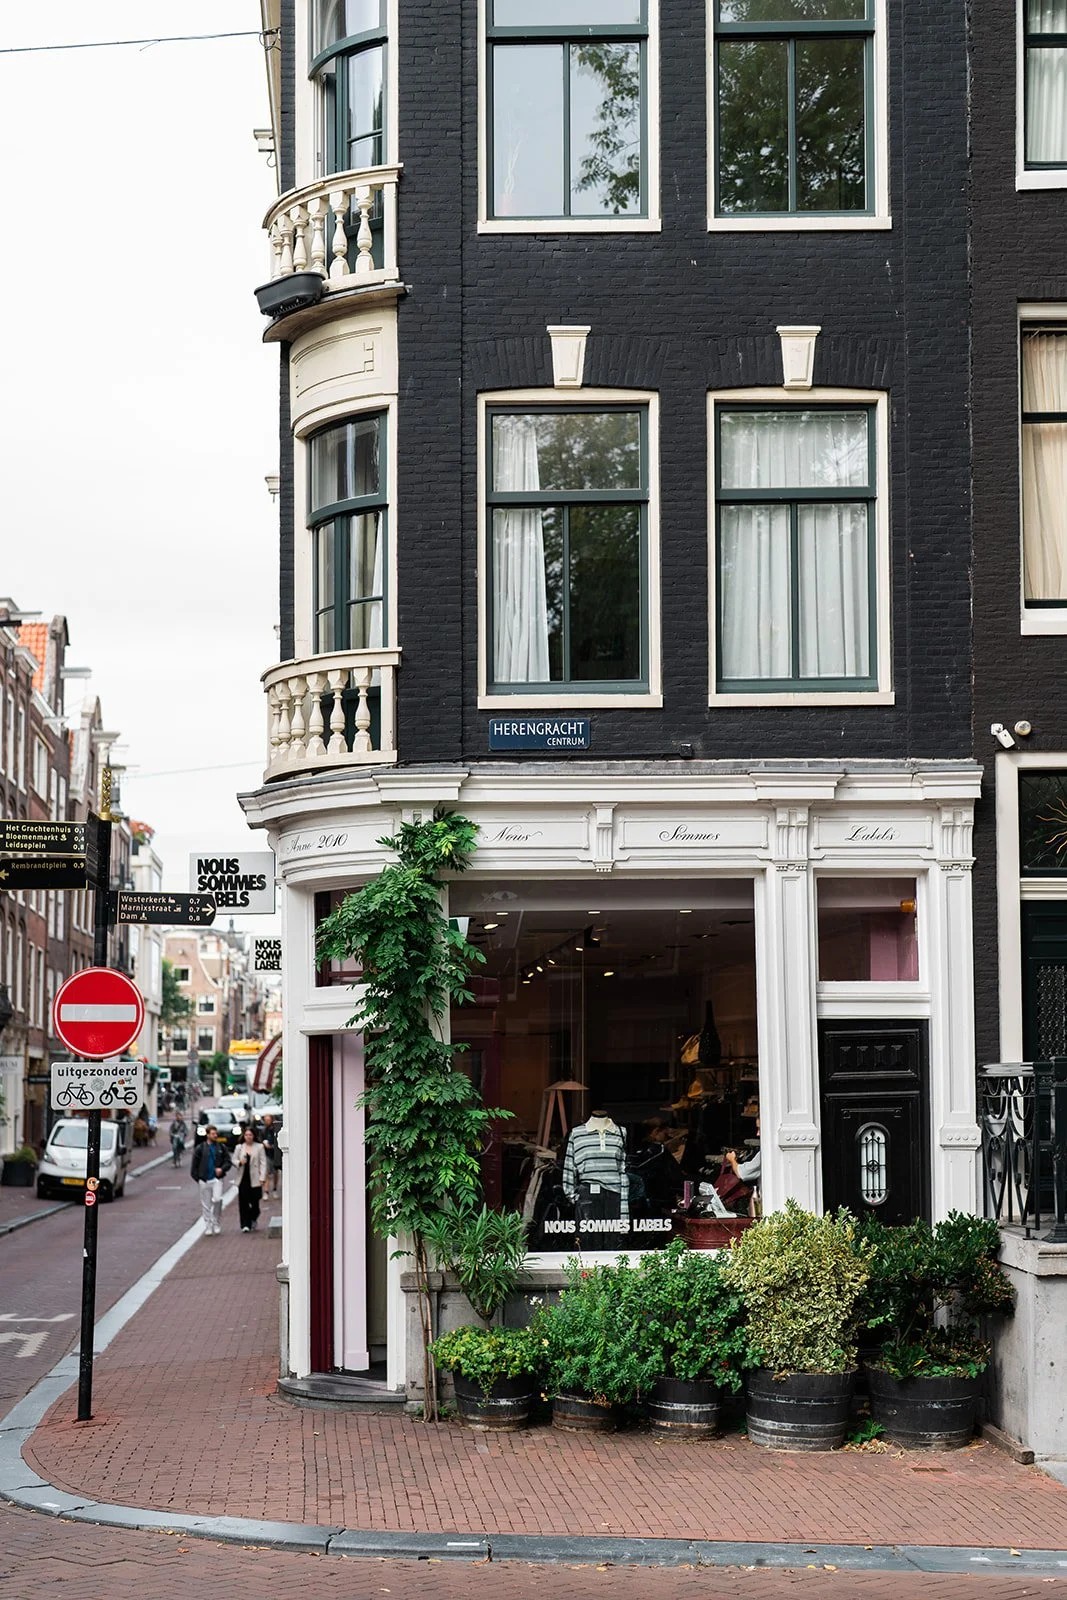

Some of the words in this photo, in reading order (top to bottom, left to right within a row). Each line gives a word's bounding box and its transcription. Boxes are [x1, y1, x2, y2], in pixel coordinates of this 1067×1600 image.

[494, 722, 584, 735] HERENGRACHT
[546, 737, 584, 745] CENTRUM
[21, 824, 71, 834] Grachtenhuis
[484, 825, 544, 842] Nous
[658, 824, 721, 842] Sommes
[844, 825, 901, 841] Labels
[5, 833, 59, 841] Bloemenmarkt
[5, 841, 46, 850] Leidseplein
[286, 834, 312, 854] Anno
[316, 833, 349, 849] 2010
[11, 862, 67, 870] Rembrandtplein
[197, 859, 240, 875] NOUS
[197, 875, 267, 891] SOMMES
[120, 895, 167, 904] Westerkerk
[213, 891, 250, 908] BELS
[120, 904, 172, 913] Marnixstraat
[255, 939, 281, 950] NOUS
[57, 1066, 138, 1079] uitgezonderd
[544, 1220, 576, 1234] NOUS
[579, 1219, 630, 1233] SOMMES
[632, 1218, 672, 1232] LABELS
